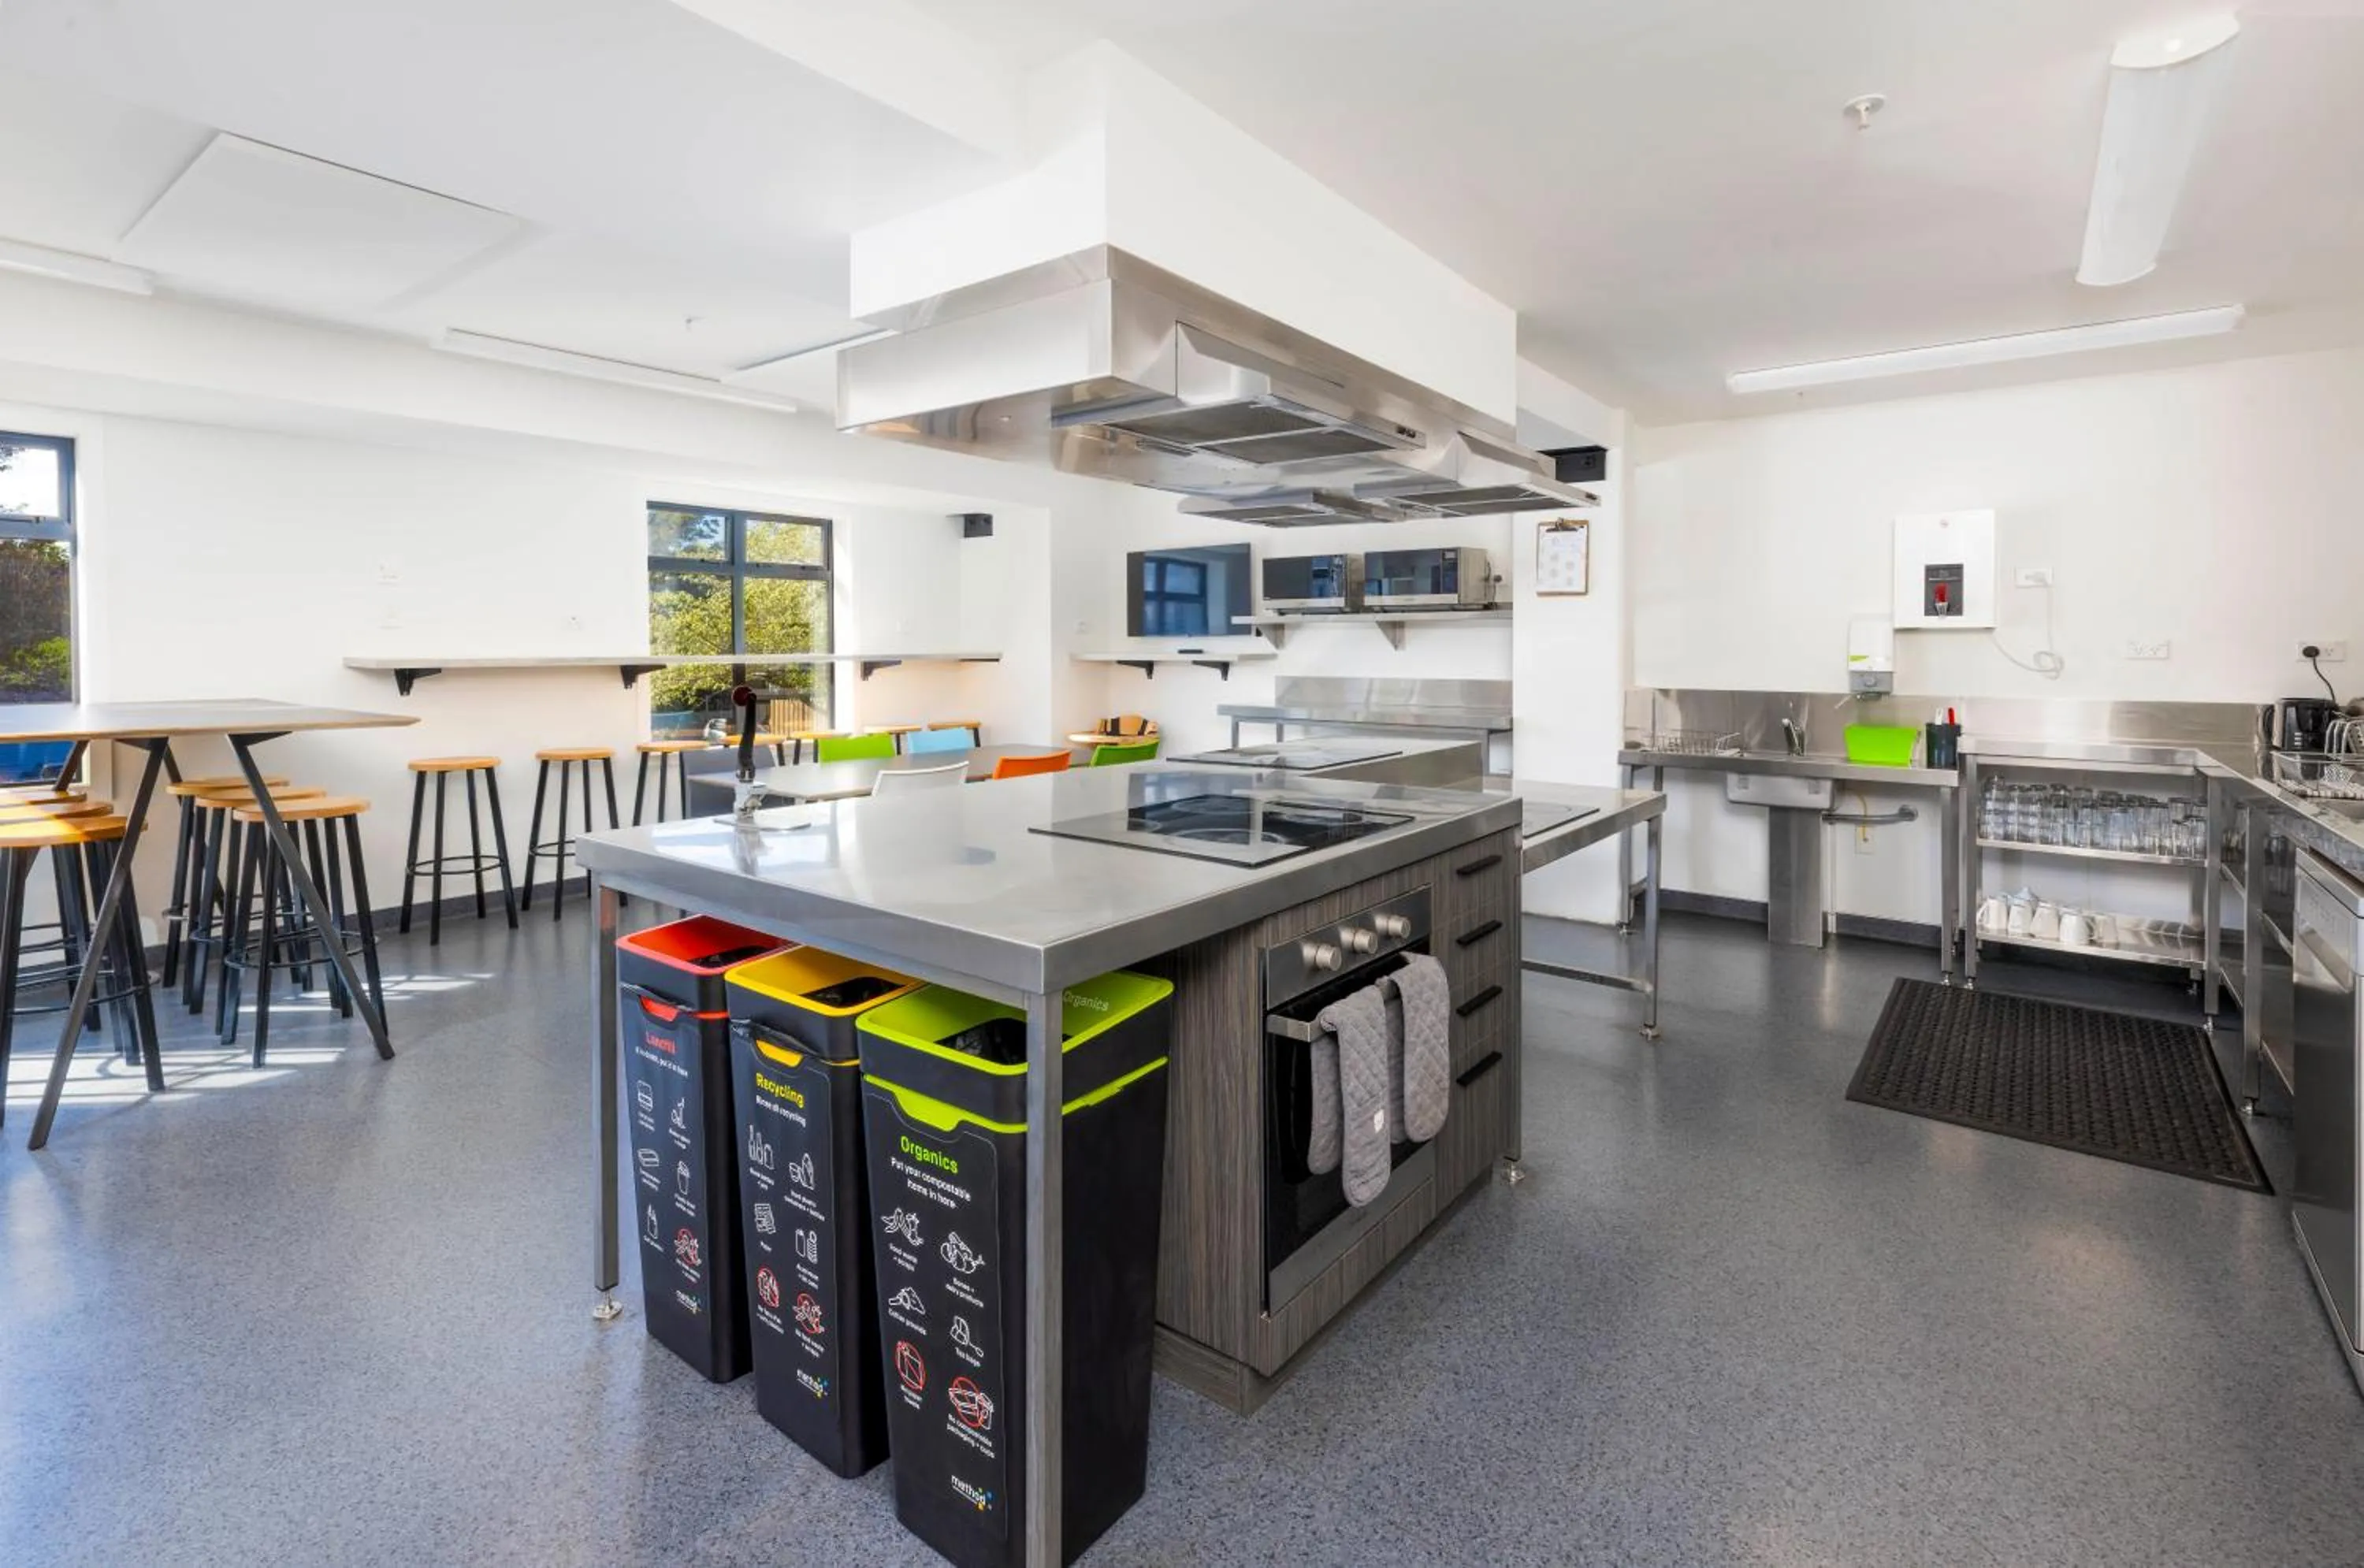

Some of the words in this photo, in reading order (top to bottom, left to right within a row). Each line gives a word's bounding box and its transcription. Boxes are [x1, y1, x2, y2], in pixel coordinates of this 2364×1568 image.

[1062, 990, 1110, 1012] Organics
[756, 1072, 805, 1109] Recycling
[779, 1107, 806, 1128] recycling
[900, 1135, 958, 1174] Organics
[890, 1157, 904, 1171] Put
[904, 1165, 921, 1178] your
[921, 1172, 971, 1202] compostable
[929, 1188, 937, 1200] in
